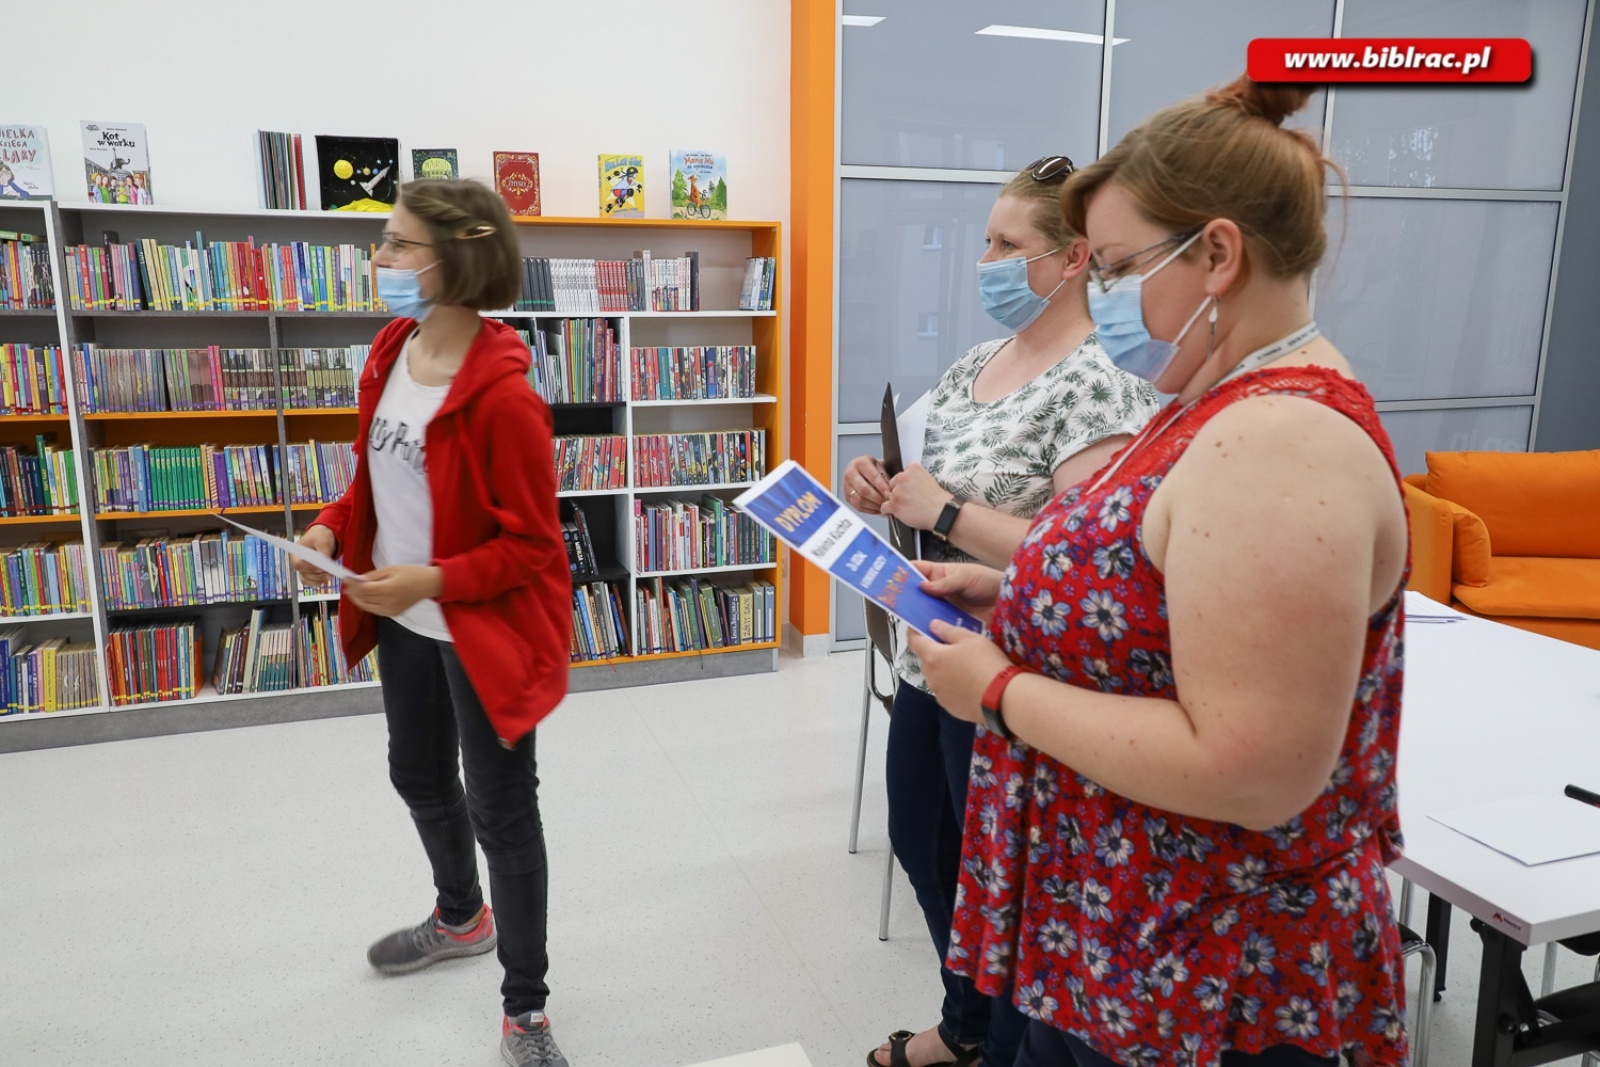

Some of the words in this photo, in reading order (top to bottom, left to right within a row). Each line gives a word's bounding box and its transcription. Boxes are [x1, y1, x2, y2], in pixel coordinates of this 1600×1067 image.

[0, 128, 35, 139] IELKA
[102, 131, 119, 141] Kot
[107, 138, 135, 148] worku
[0, 149, 36, 164] LARY
[774, 490, 823, 533] DYPLOM
